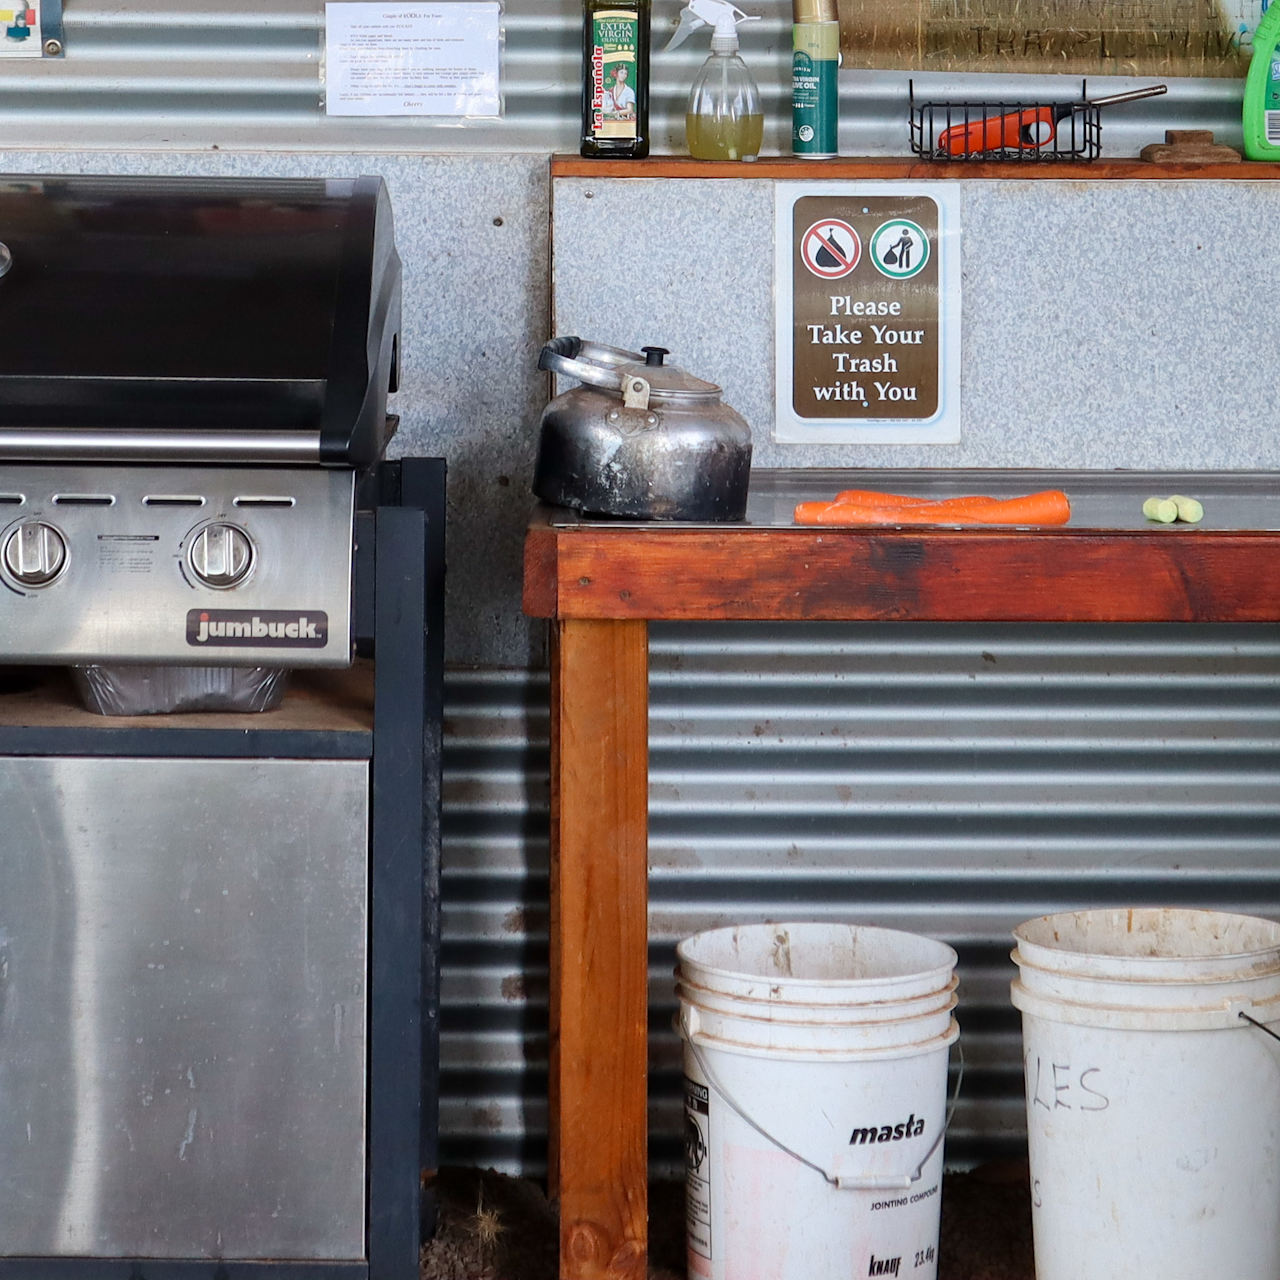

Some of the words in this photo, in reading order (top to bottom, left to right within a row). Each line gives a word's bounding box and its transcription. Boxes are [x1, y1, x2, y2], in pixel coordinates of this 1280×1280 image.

[598, 30, 633, 38] VIRGIN
[600, 22, 632, 30] EXTRA
[592, 46, 604, 110] Española
[592, 113, 603, 132] La
[829, 295, 901, 316] Please
[807, 324, 863, 345] Take
[870, 324, 925, 345] Your
[832, 352, 898, 374] Trash
[812, 381, 866, 402] with
[874, 381, 918, 402] You
[196, 612, 318, 642] jumbuck
[850, 1114, 925, 1146] masta
[870, 1197, 908, 1212] JOINTING
[868, 1254, 902, 1278] KNAUF
